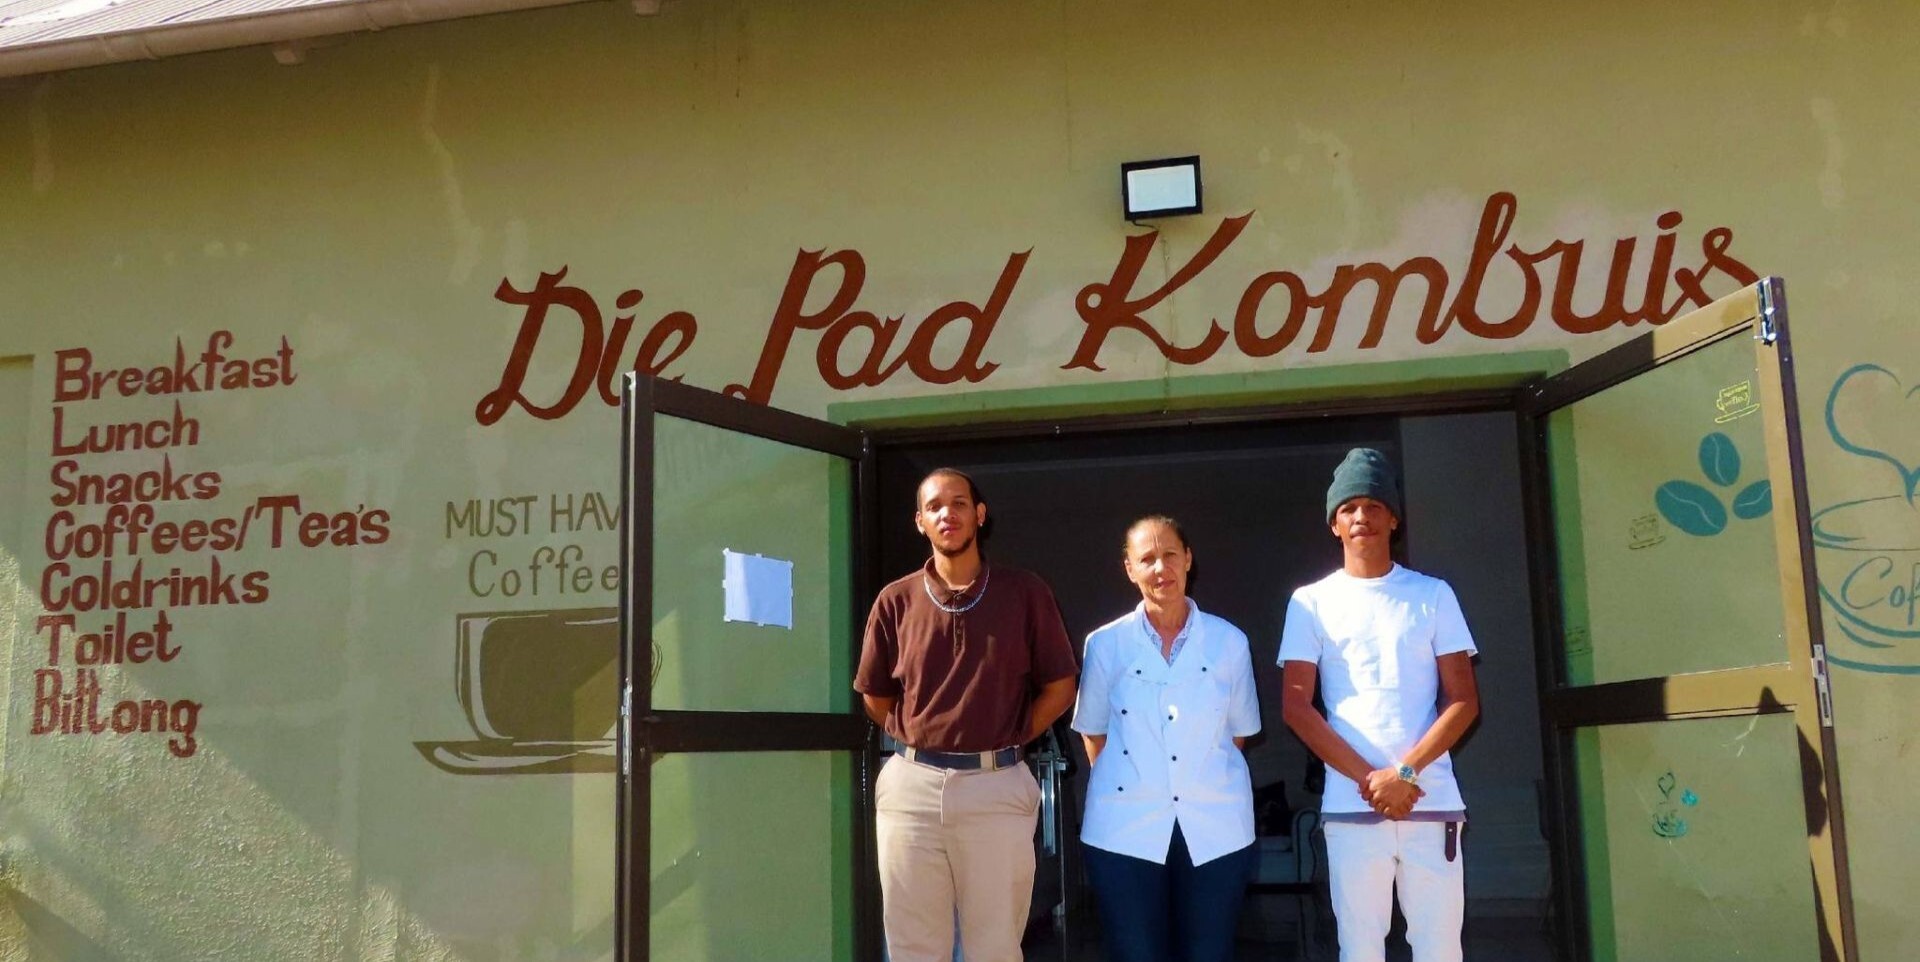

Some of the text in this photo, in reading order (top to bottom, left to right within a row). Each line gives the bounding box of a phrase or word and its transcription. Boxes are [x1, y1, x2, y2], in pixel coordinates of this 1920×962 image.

[475, 191, 1760, 426] Die Pad Kombuis
[53, 330, 298, 402] Breakfast
[51, 399, 199, 456] Lunch
[50, 452, 221, 506] Snacks
[45, 495, 391, 560] Coffees/Tea's
[445, 492, 620, 538] MUST HAV
[40, 555, 270, 611] Coldrinks
[469, 544, 619, 597] Coffee
[36, 610, 182, 666] Toilet
[30, 668, 203, 758] Biltong
